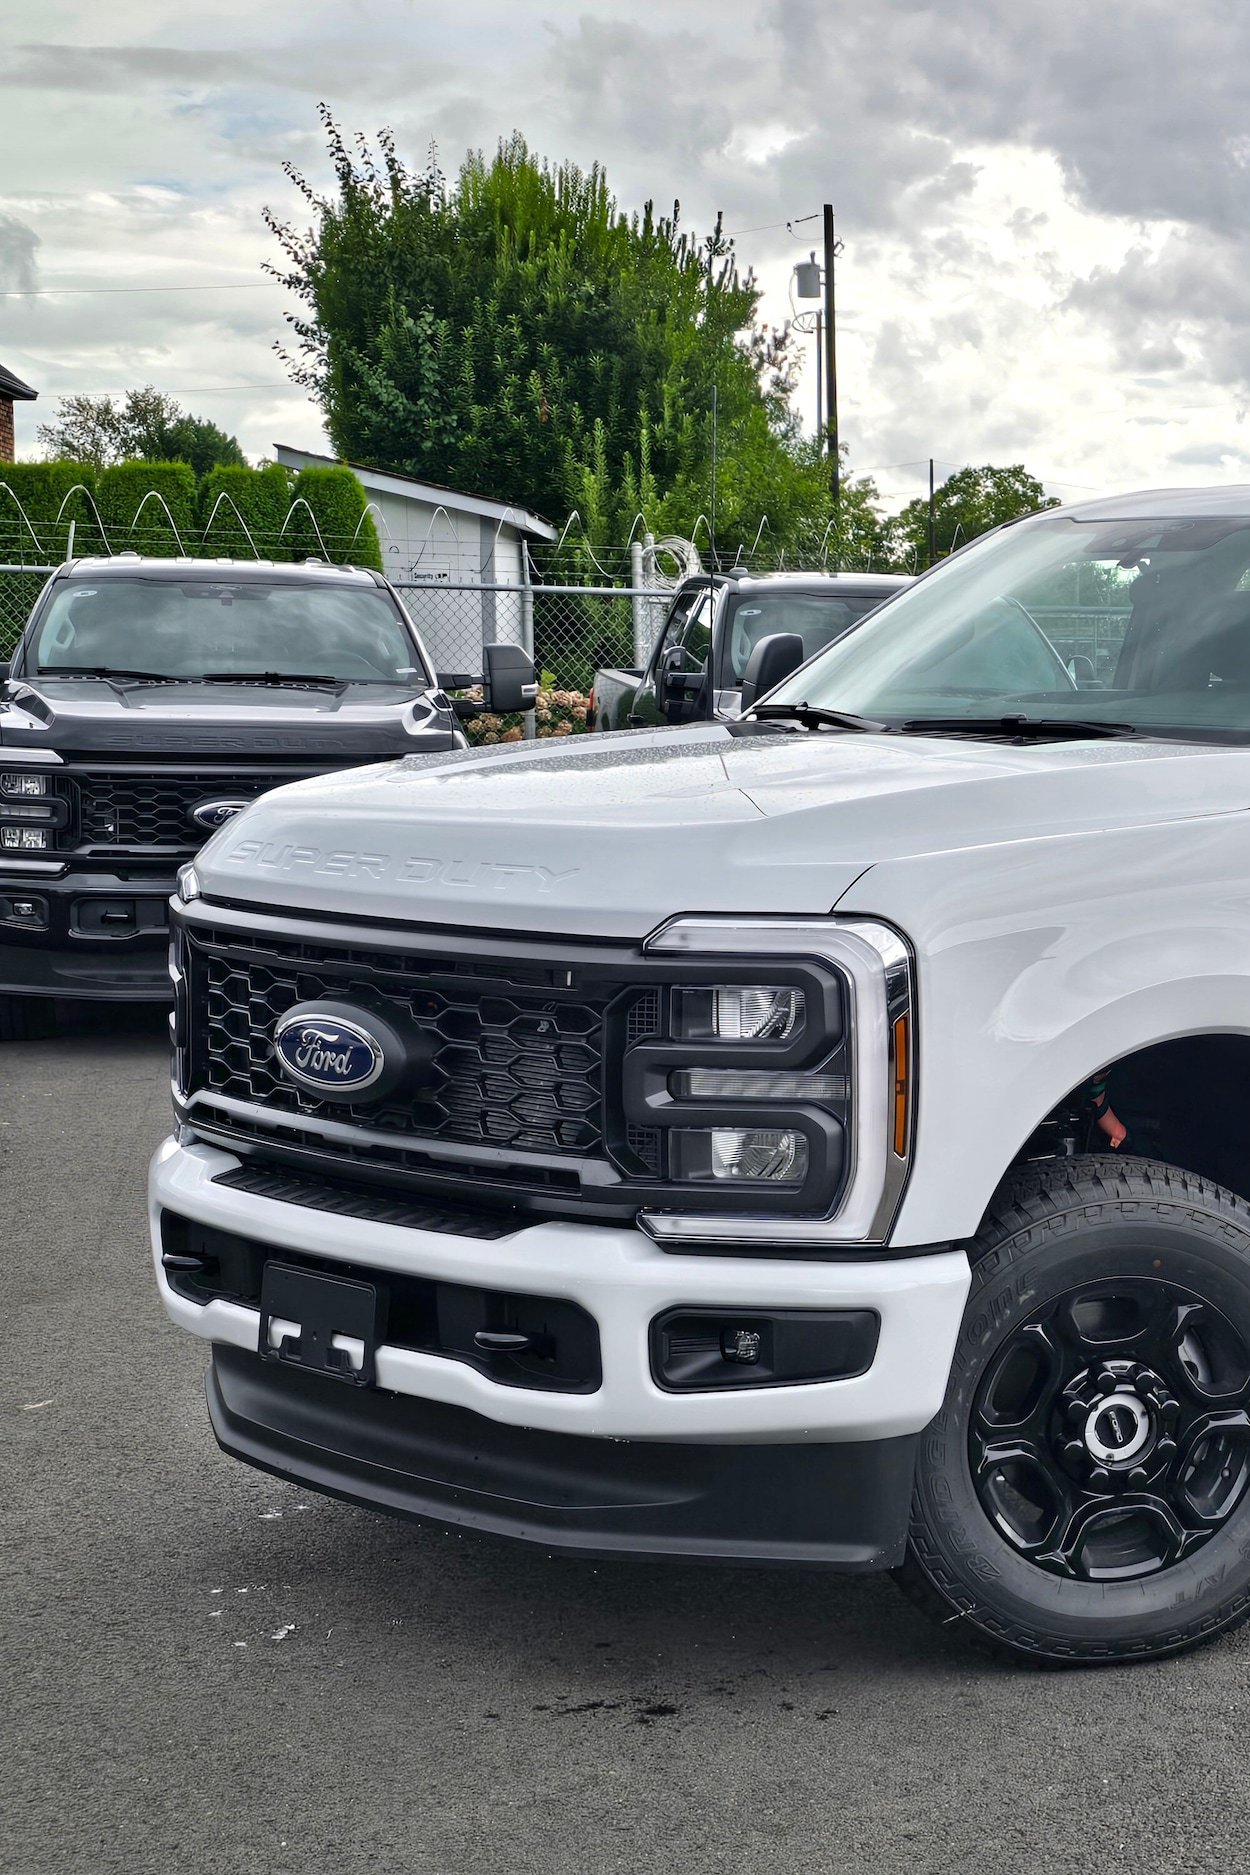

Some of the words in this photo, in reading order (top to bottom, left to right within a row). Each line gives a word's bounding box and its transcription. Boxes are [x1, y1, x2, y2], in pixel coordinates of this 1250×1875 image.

[107, 734, 244, 748] SUPER
[226, 840, 391, 880] SUPER
[395, 856, 582, 893] DUTY
[295, 1028, 353, 1076] Ford
